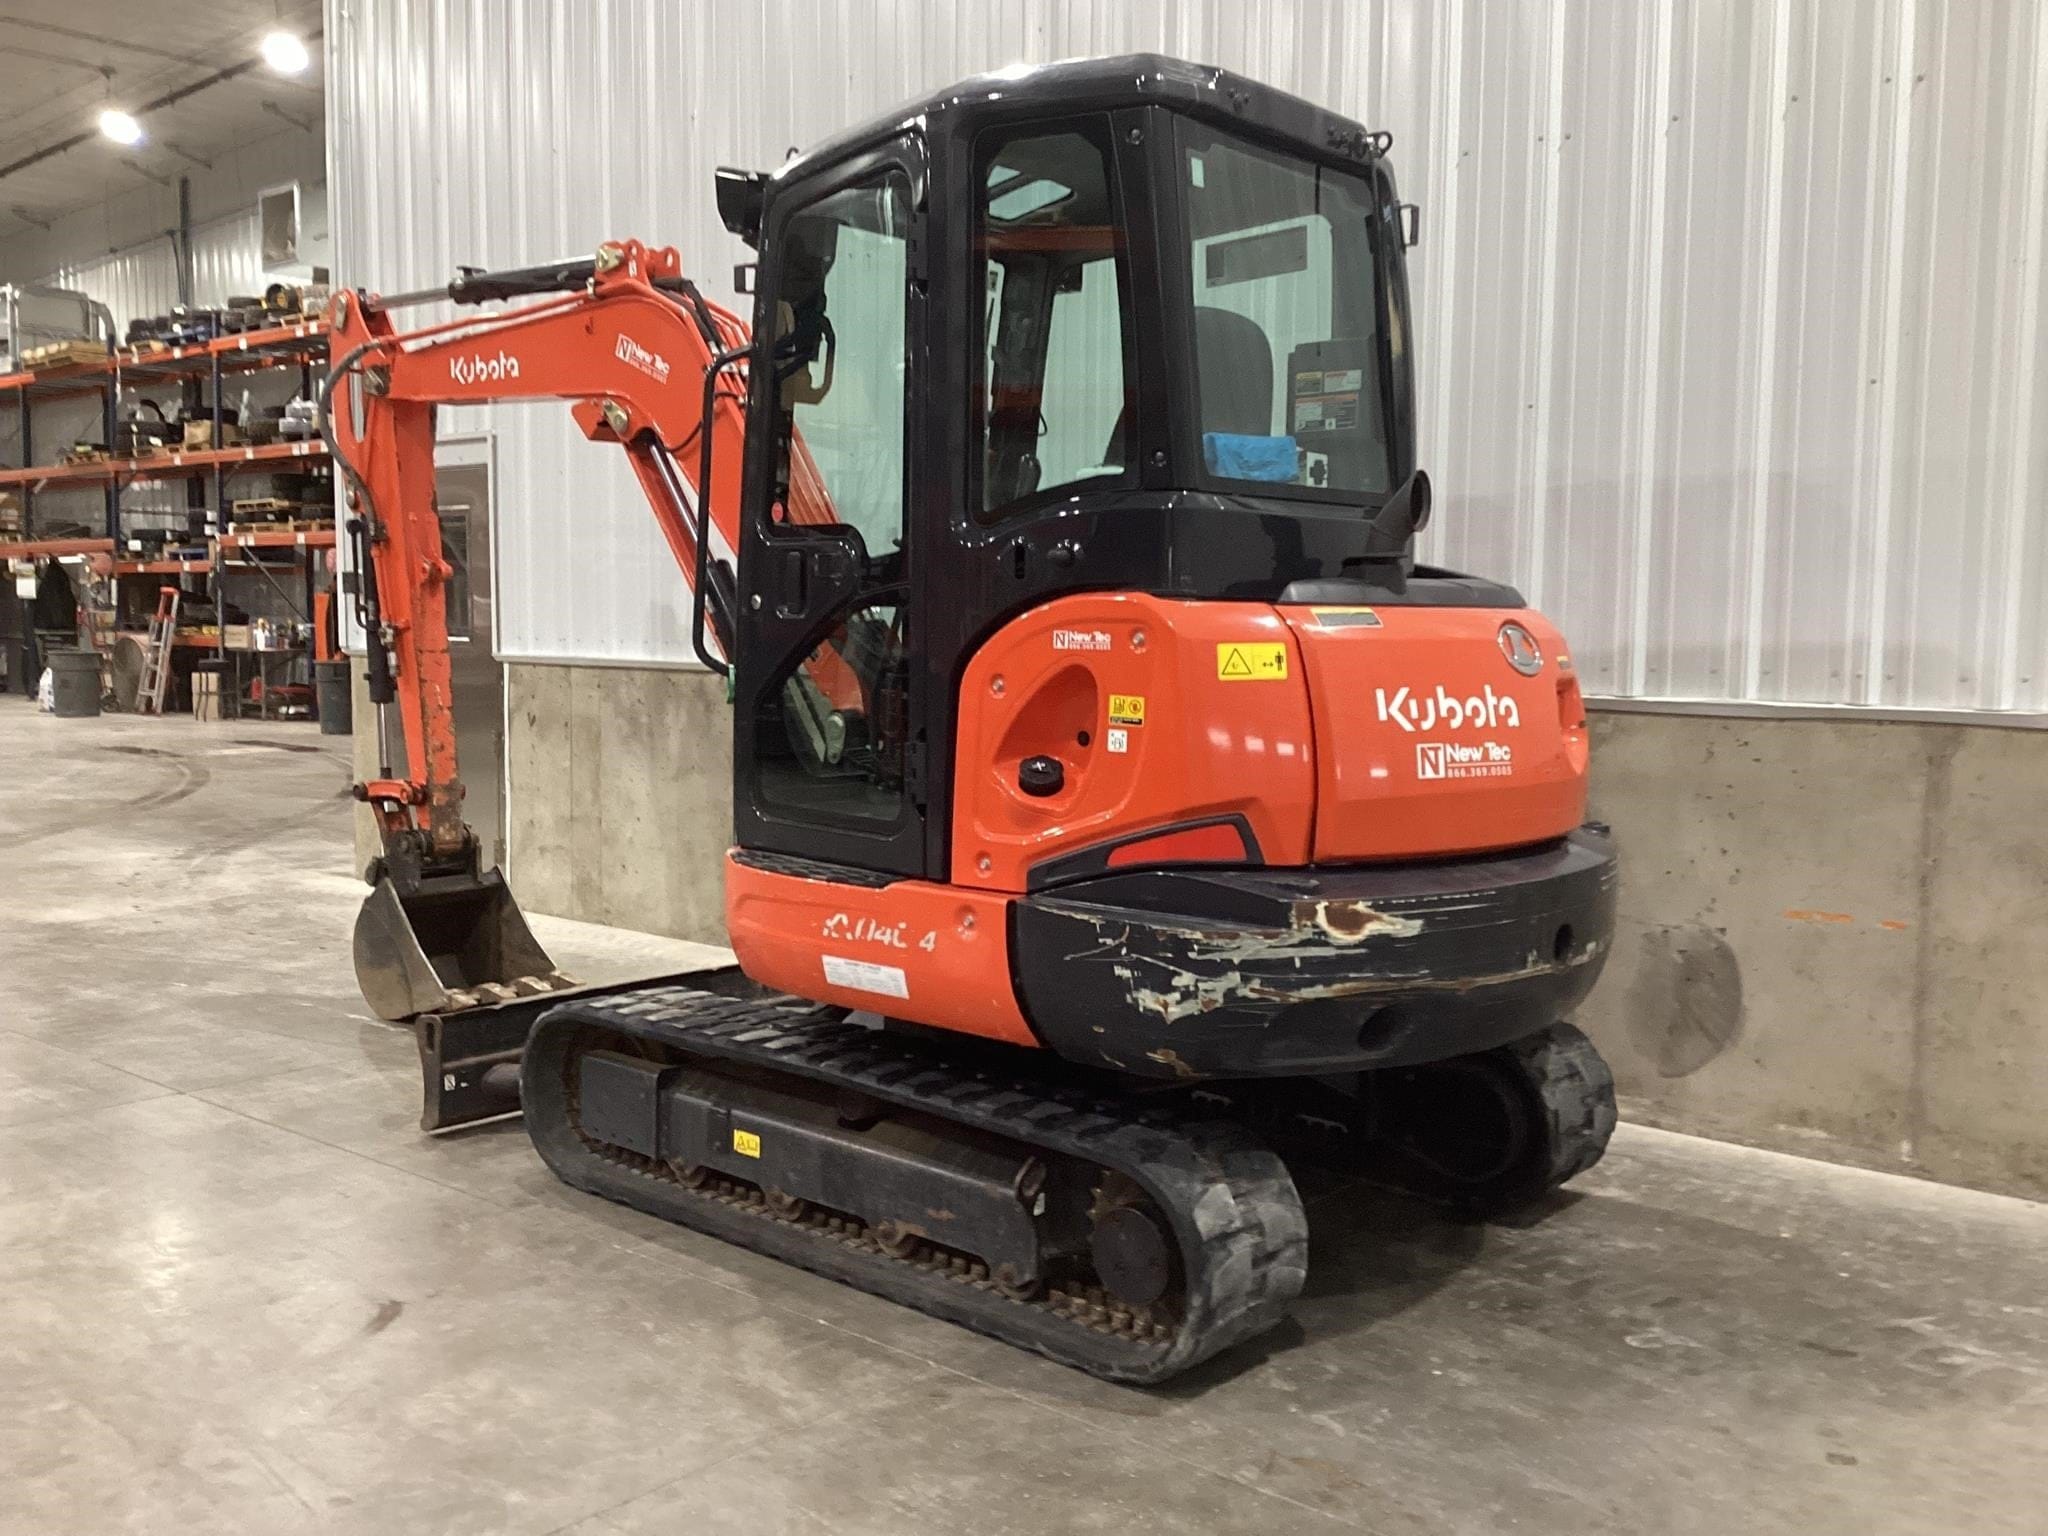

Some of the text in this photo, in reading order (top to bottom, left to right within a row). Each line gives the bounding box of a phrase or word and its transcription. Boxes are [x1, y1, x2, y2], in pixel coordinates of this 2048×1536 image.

[450, 350, 520, 384] Kubota
[1069, 631, 1092, 642] New
[1375, 684, 1520, 732] Kubota
[1446, 743, 1484, 762] New
[1484, 741, 1511, 761] Tec
